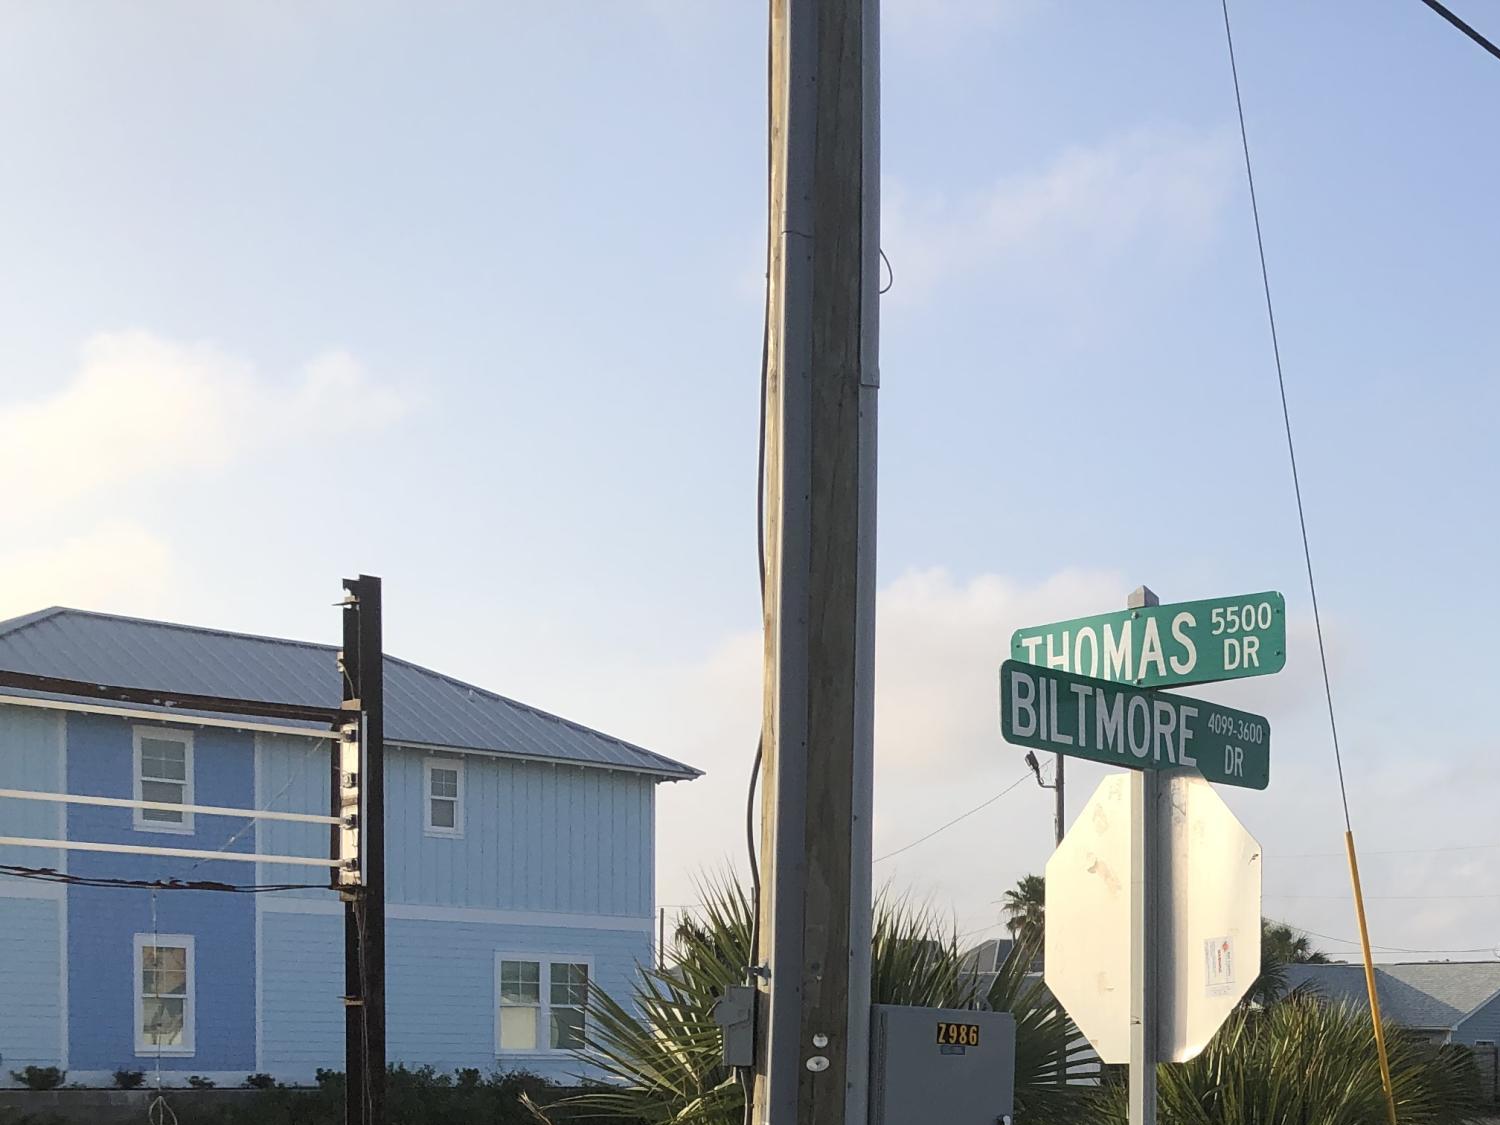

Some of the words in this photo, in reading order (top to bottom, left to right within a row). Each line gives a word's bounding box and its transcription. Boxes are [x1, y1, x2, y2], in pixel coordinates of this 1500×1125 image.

[1211, 602, 1272, 635] 5500
[1021, 611, 1197, 681] THOMAS
[1223, 636, 1259, 670] DR
[1011, 670, 1199, 767] BILTMORE
[1207, 712, 1263, 745] 4099-3600
[1224, 744, 1244, 777] DR
